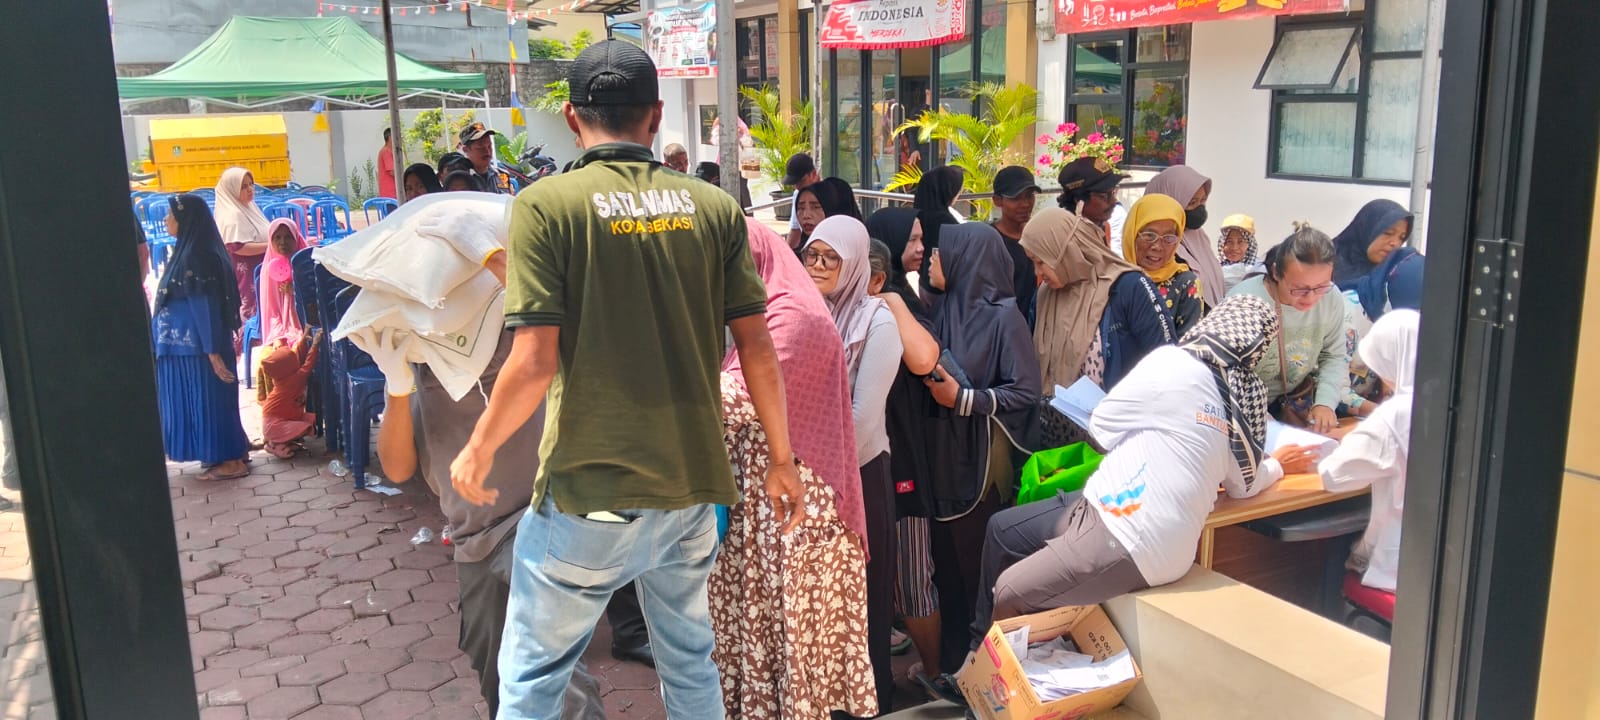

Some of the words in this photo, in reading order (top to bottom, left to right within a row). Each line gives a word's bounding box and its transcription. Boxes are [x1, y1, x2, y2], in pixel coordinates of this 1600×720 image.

[857, 6, 924, 21] INDONESIA
[593, 189, 696, 218] SATLNMAS
[610, 219, 647, 235] KOA
[647, 216, 694, 233] BEKASI
[1140, 276, 1157, 303] CHANEL
[1159, 313, 1172, 342] CHANEL
